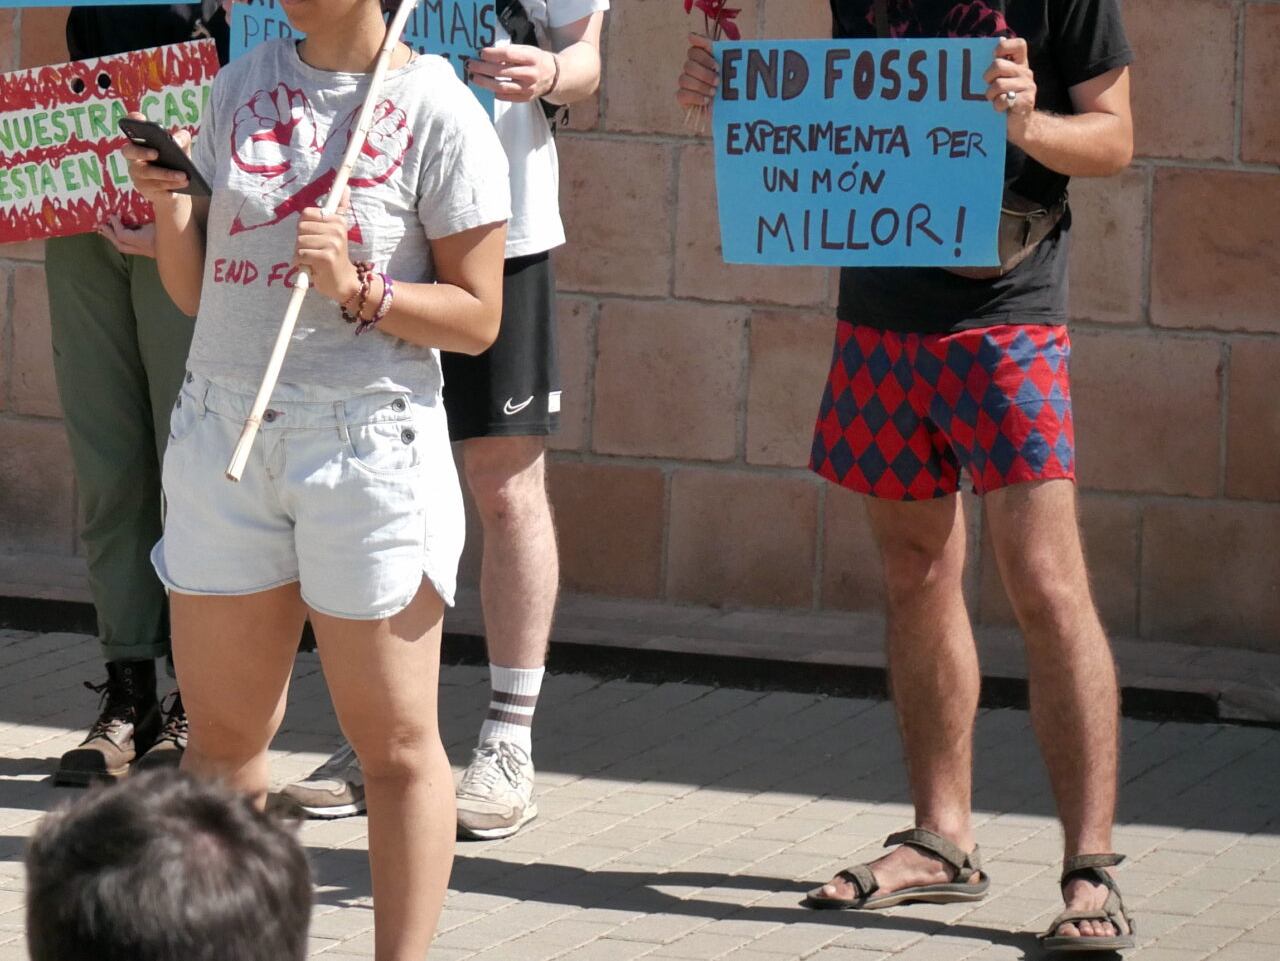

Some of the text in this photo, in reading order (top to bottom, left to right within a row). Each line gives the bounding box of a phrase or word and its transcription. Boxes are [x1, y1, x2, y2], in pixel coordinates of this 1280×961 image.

[721, 47, 989, 102] END FOSSIL
[726, 120, 988, 158] EXPERIMENTA PER
[61, 155, 103, 192] EN
[763, 161, 886, 194] UN MÓN
[756, 203, 967, 258] MILLOR!
[214, 258, 259, 286] END
